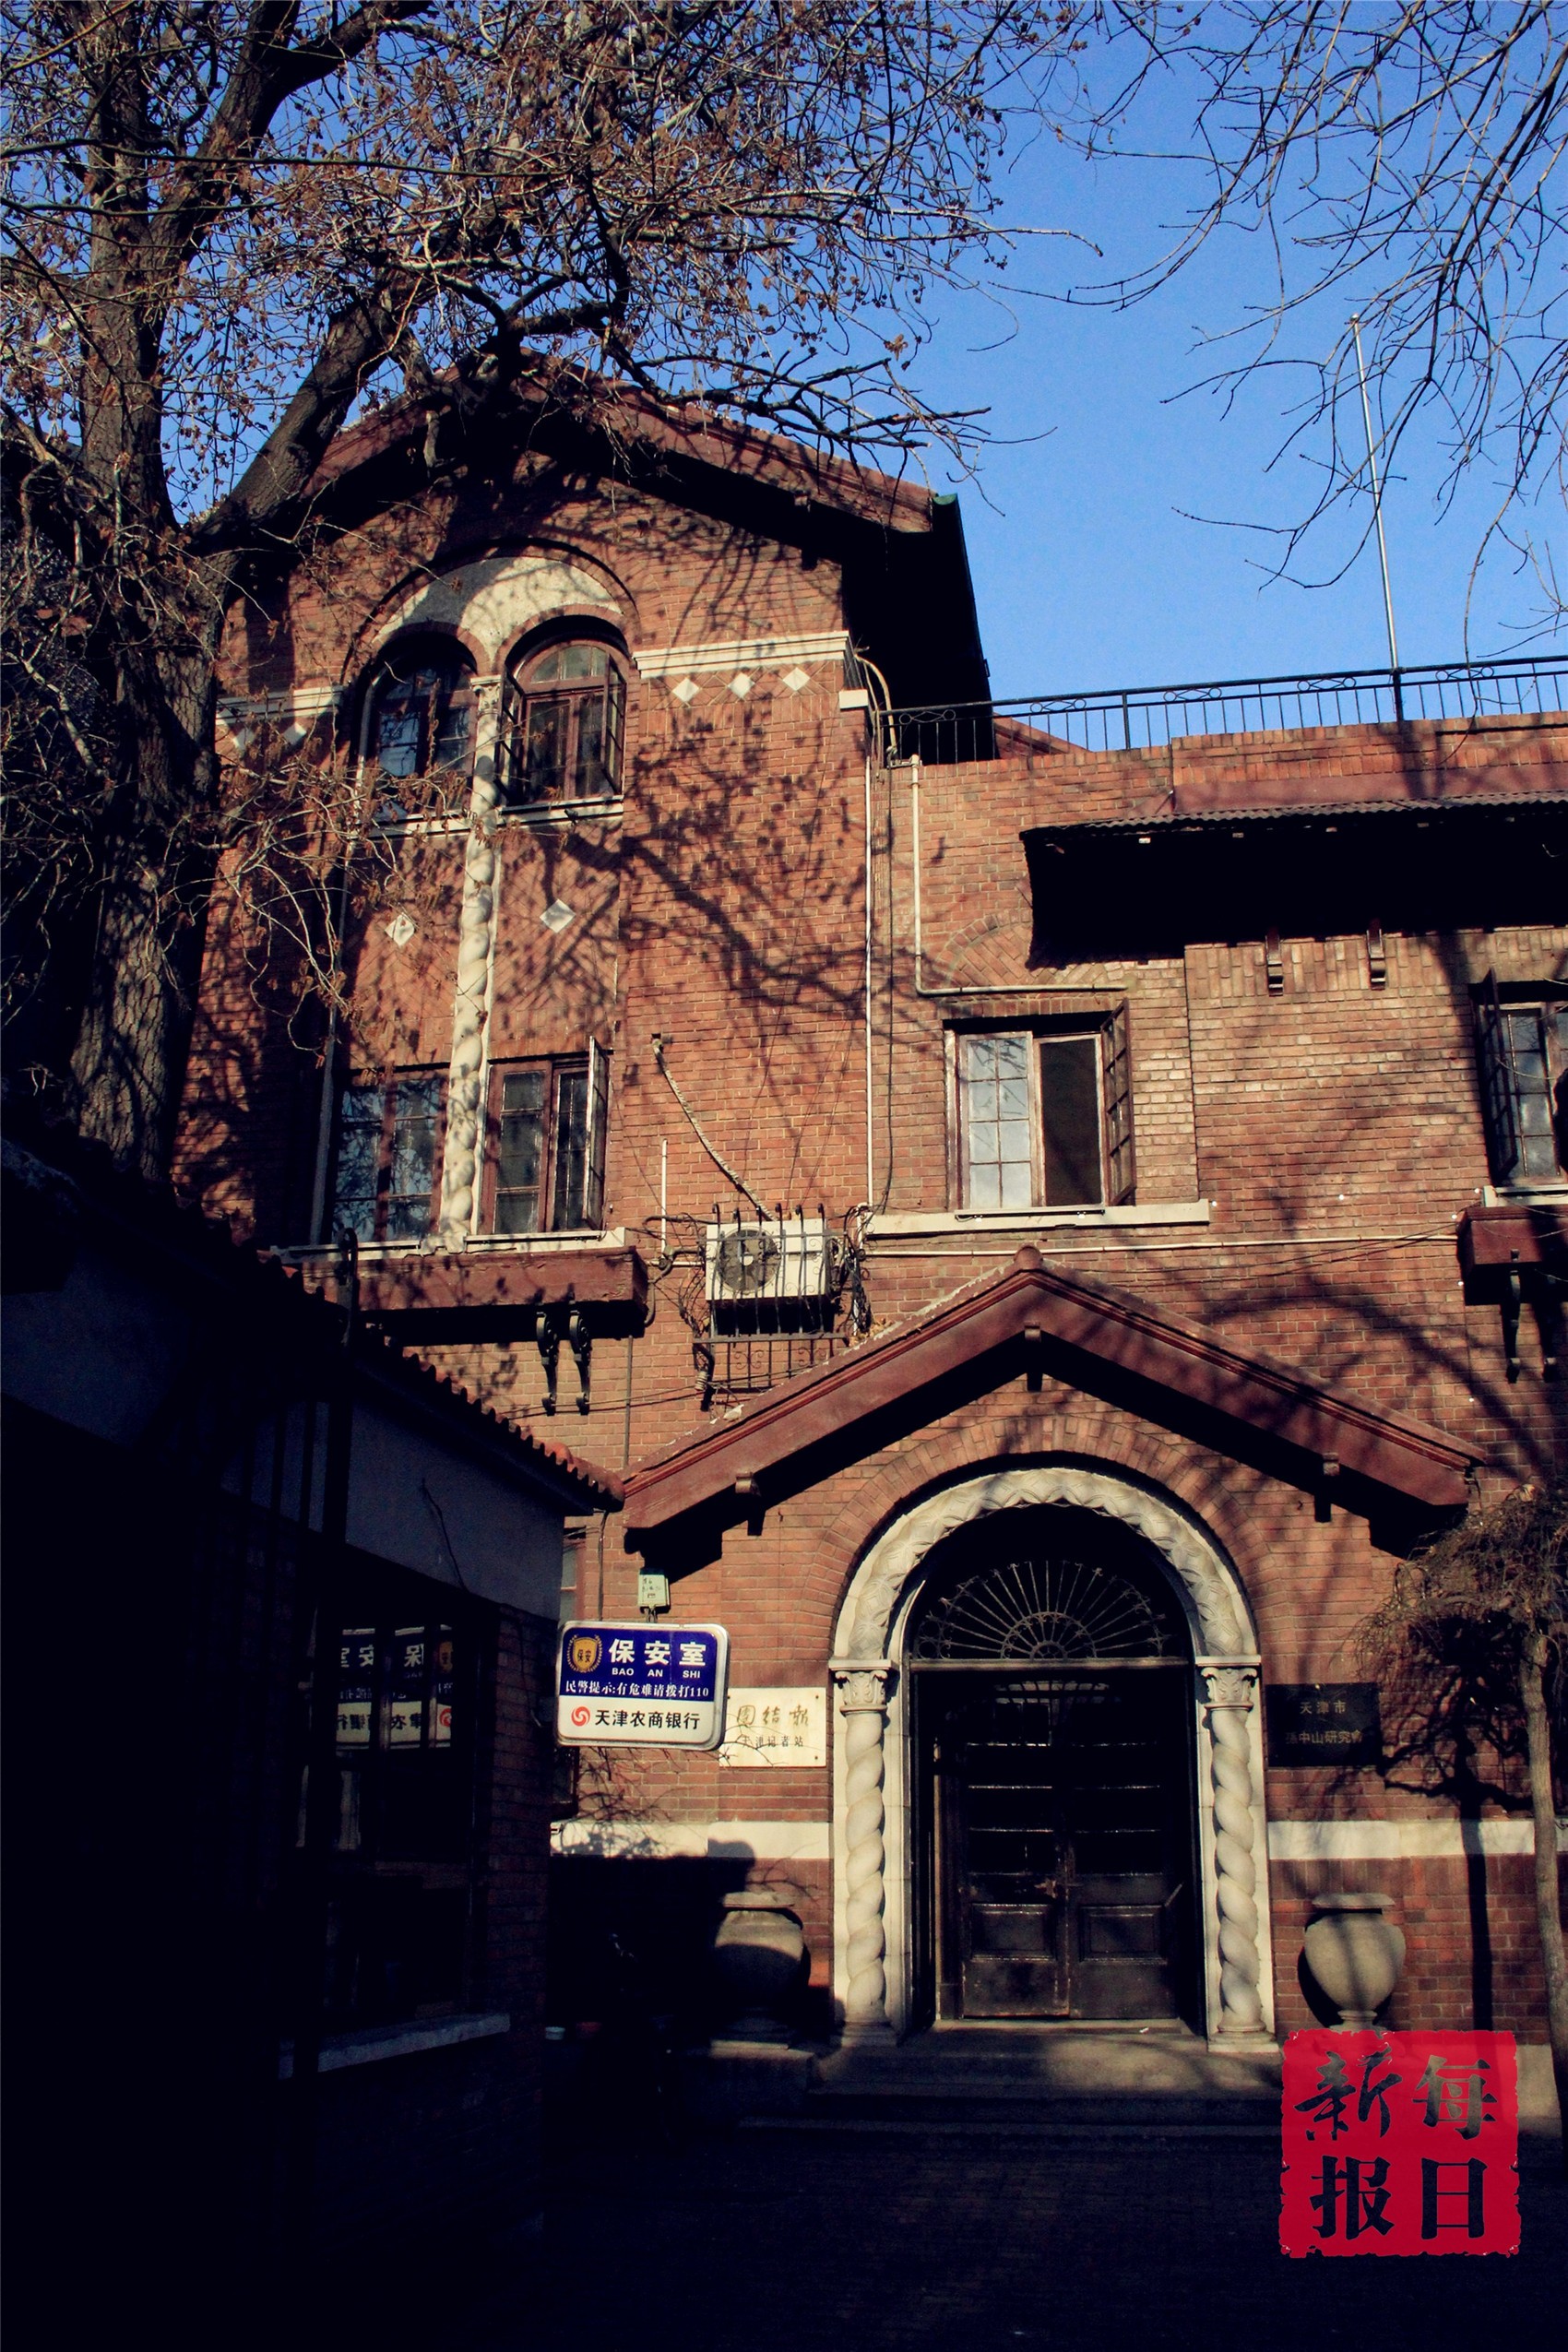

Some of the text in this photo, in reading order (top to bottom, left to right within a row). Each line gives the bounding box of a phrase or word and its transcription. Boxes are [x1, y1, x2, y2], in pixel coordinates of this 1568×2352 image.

[577, 1648, 592, 1663] 保安
[609, 1638, 707, 1667] 保安室
[612, 1668, 700, 1679] BAO AN SHI
[1299, 1700, 1347, 1715] 天津市
[595, 1709, 700, 1730] 天津农商银行
